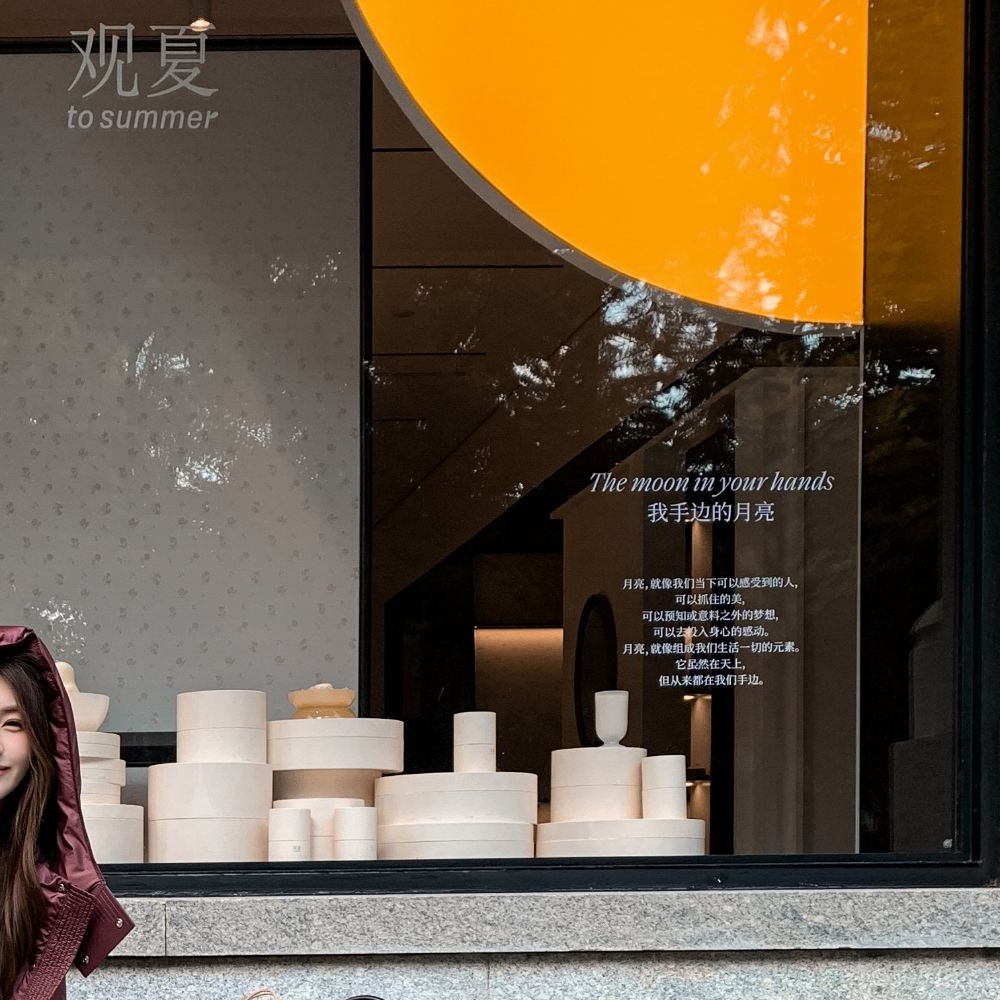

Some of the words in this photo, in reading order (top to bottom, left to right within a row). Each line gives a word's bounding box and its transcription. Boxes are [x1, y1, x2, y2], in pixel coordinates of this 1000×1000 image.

[68, 22, 219, 98] 观夏
[67, 105, 94, 129] to
[99, 110, 219, 129] summer
[590, 472, 626, 492] The
[631, 474, 689, 492] moon
[693, 472, 715, 492] in
[711, 473, 768, 498] your
[771, 470, 835, 492] hands
[648, 501, 775, 523] 我手边的月亮
